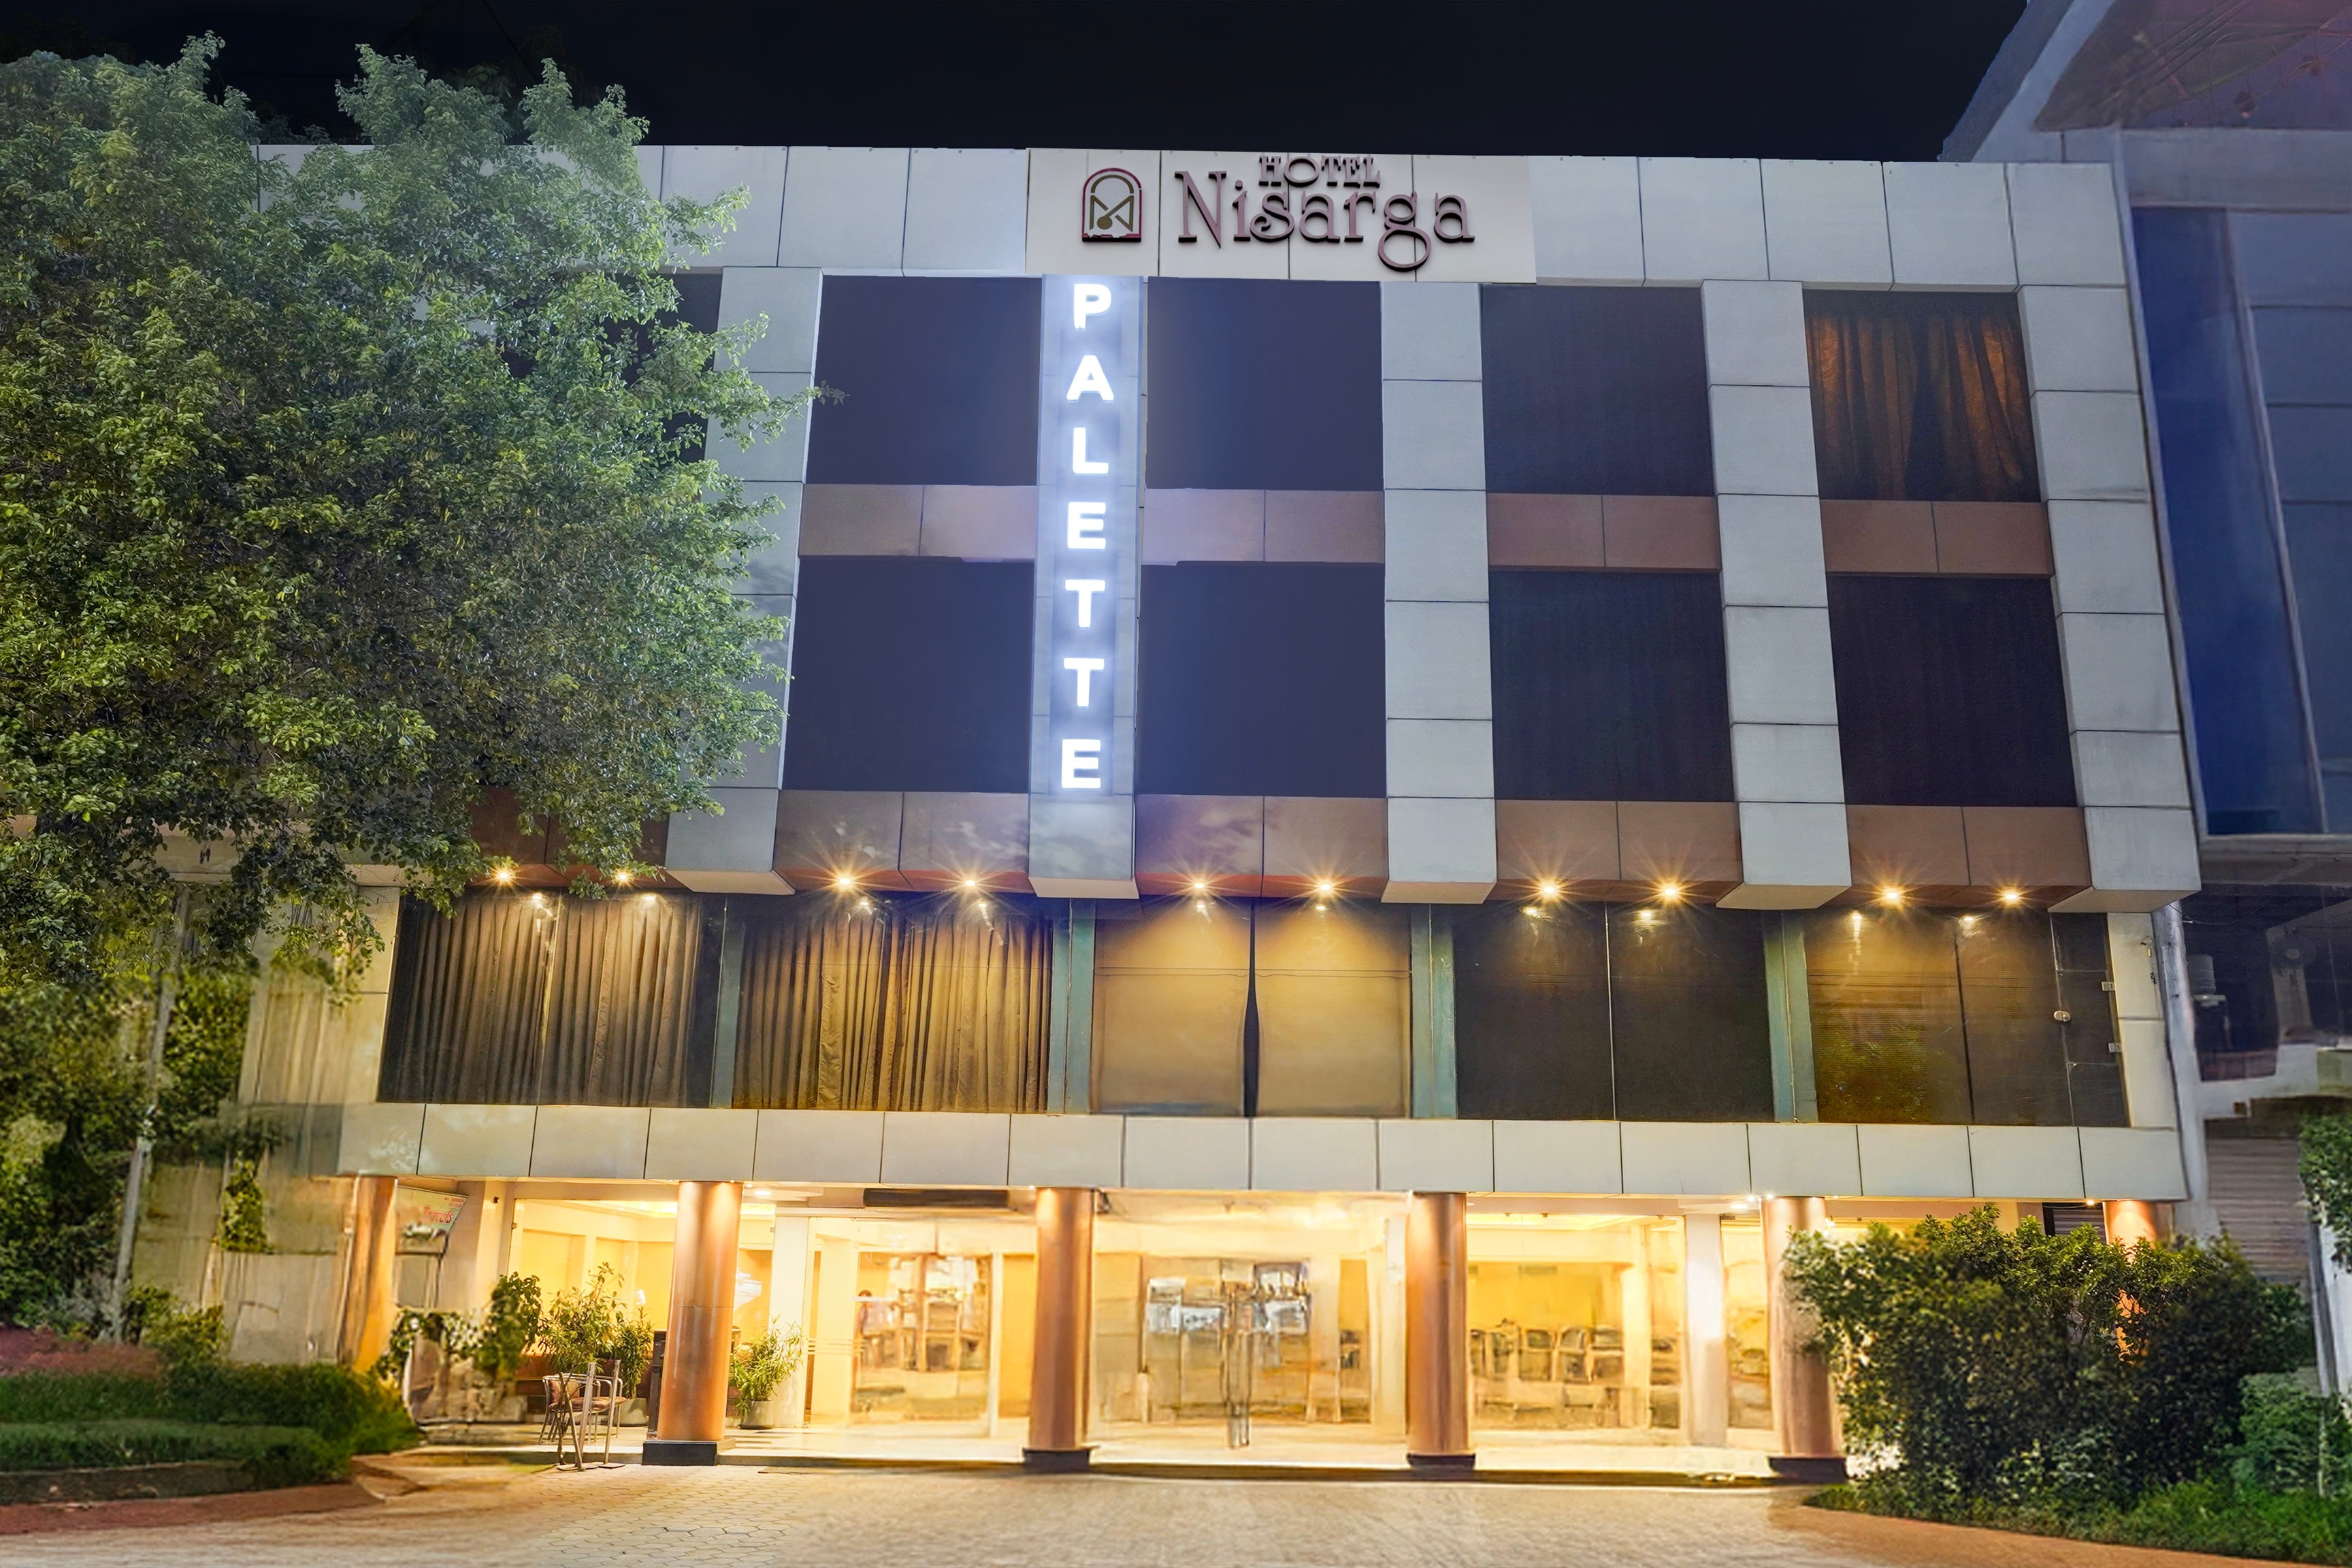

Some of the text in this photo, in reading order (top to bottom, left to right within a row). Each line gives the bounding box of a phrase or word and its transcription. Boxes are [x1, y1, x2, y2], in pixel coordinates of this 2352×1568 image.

[1174, 169, 1475, 272] Nisarga
[1258, 155, 1381, 189] HOTEL
[1061, 282, 1115, 790] PALETTE
